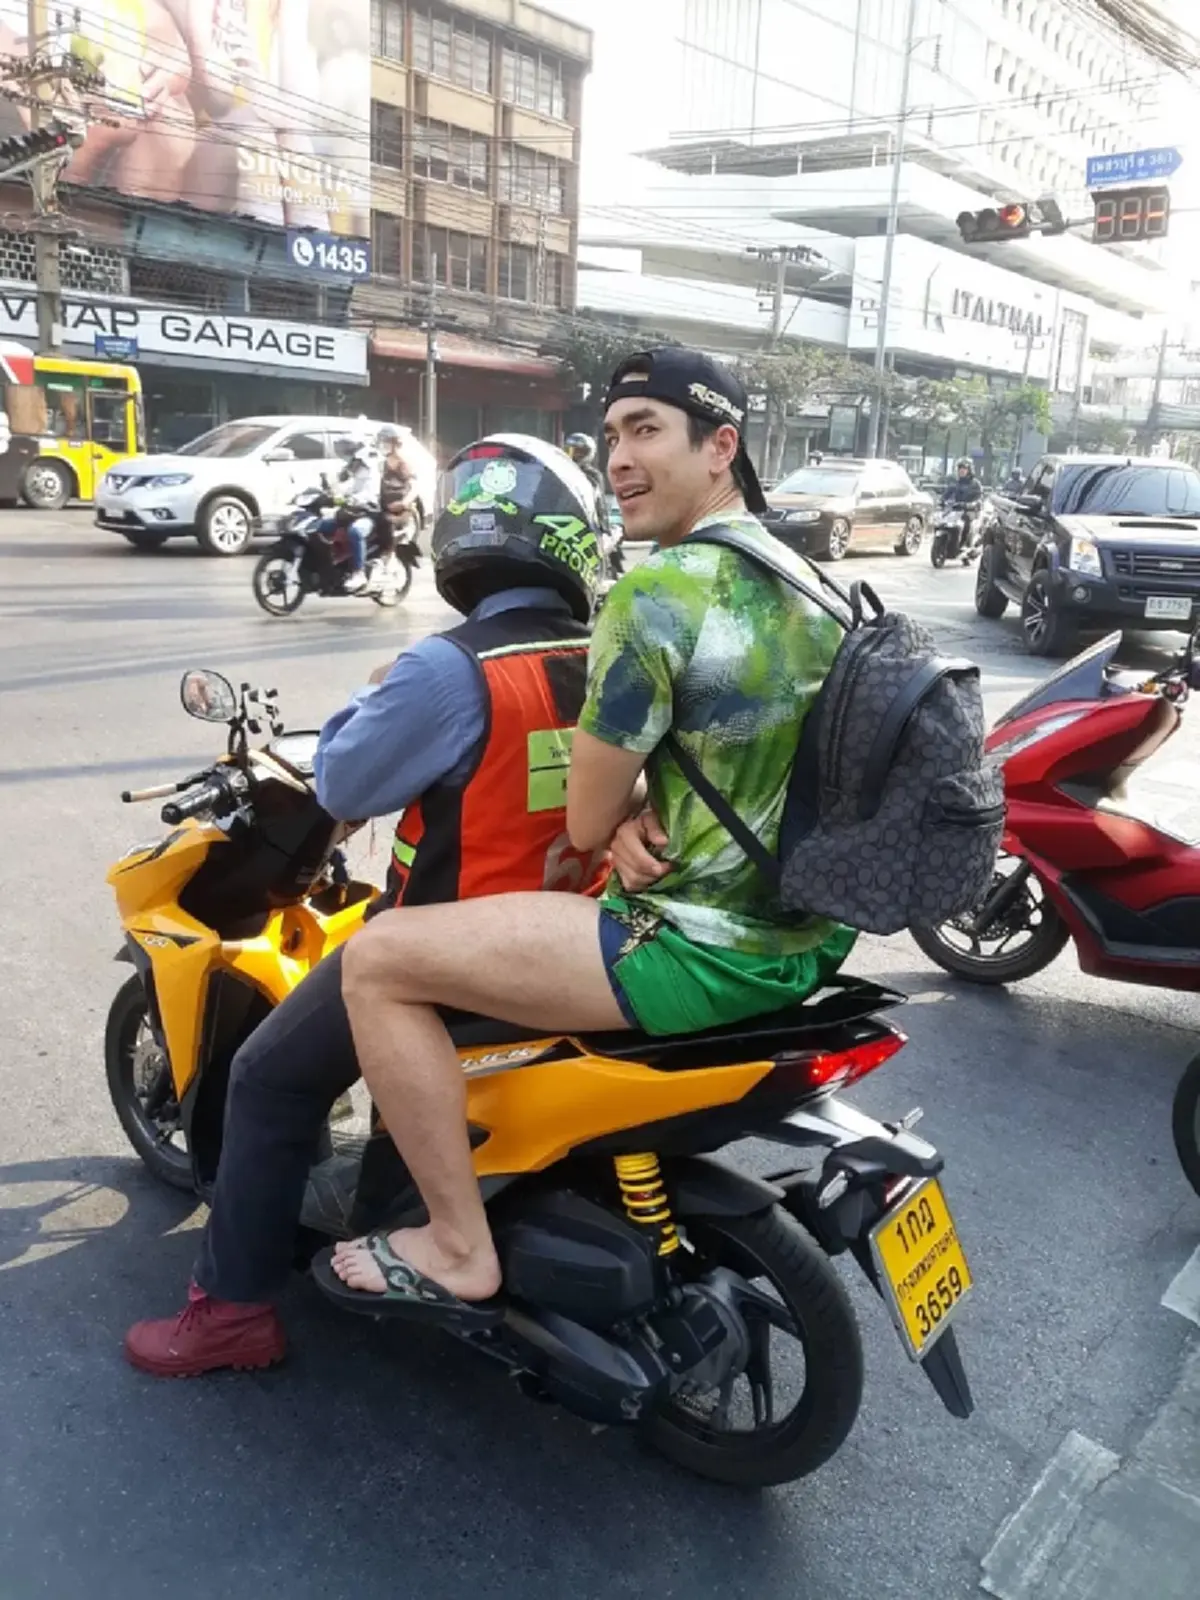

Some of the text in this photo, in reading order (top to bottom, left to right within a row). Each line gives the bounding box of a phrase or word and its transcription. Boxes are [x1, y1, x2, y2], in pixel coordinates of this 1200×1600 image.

[237, 147, 353, 196] SINGHA
[316, 242, 367, 274] 1435
[161, 315, 335, 360] GARAGE
[916, 1266, 962, 1337] 3659
